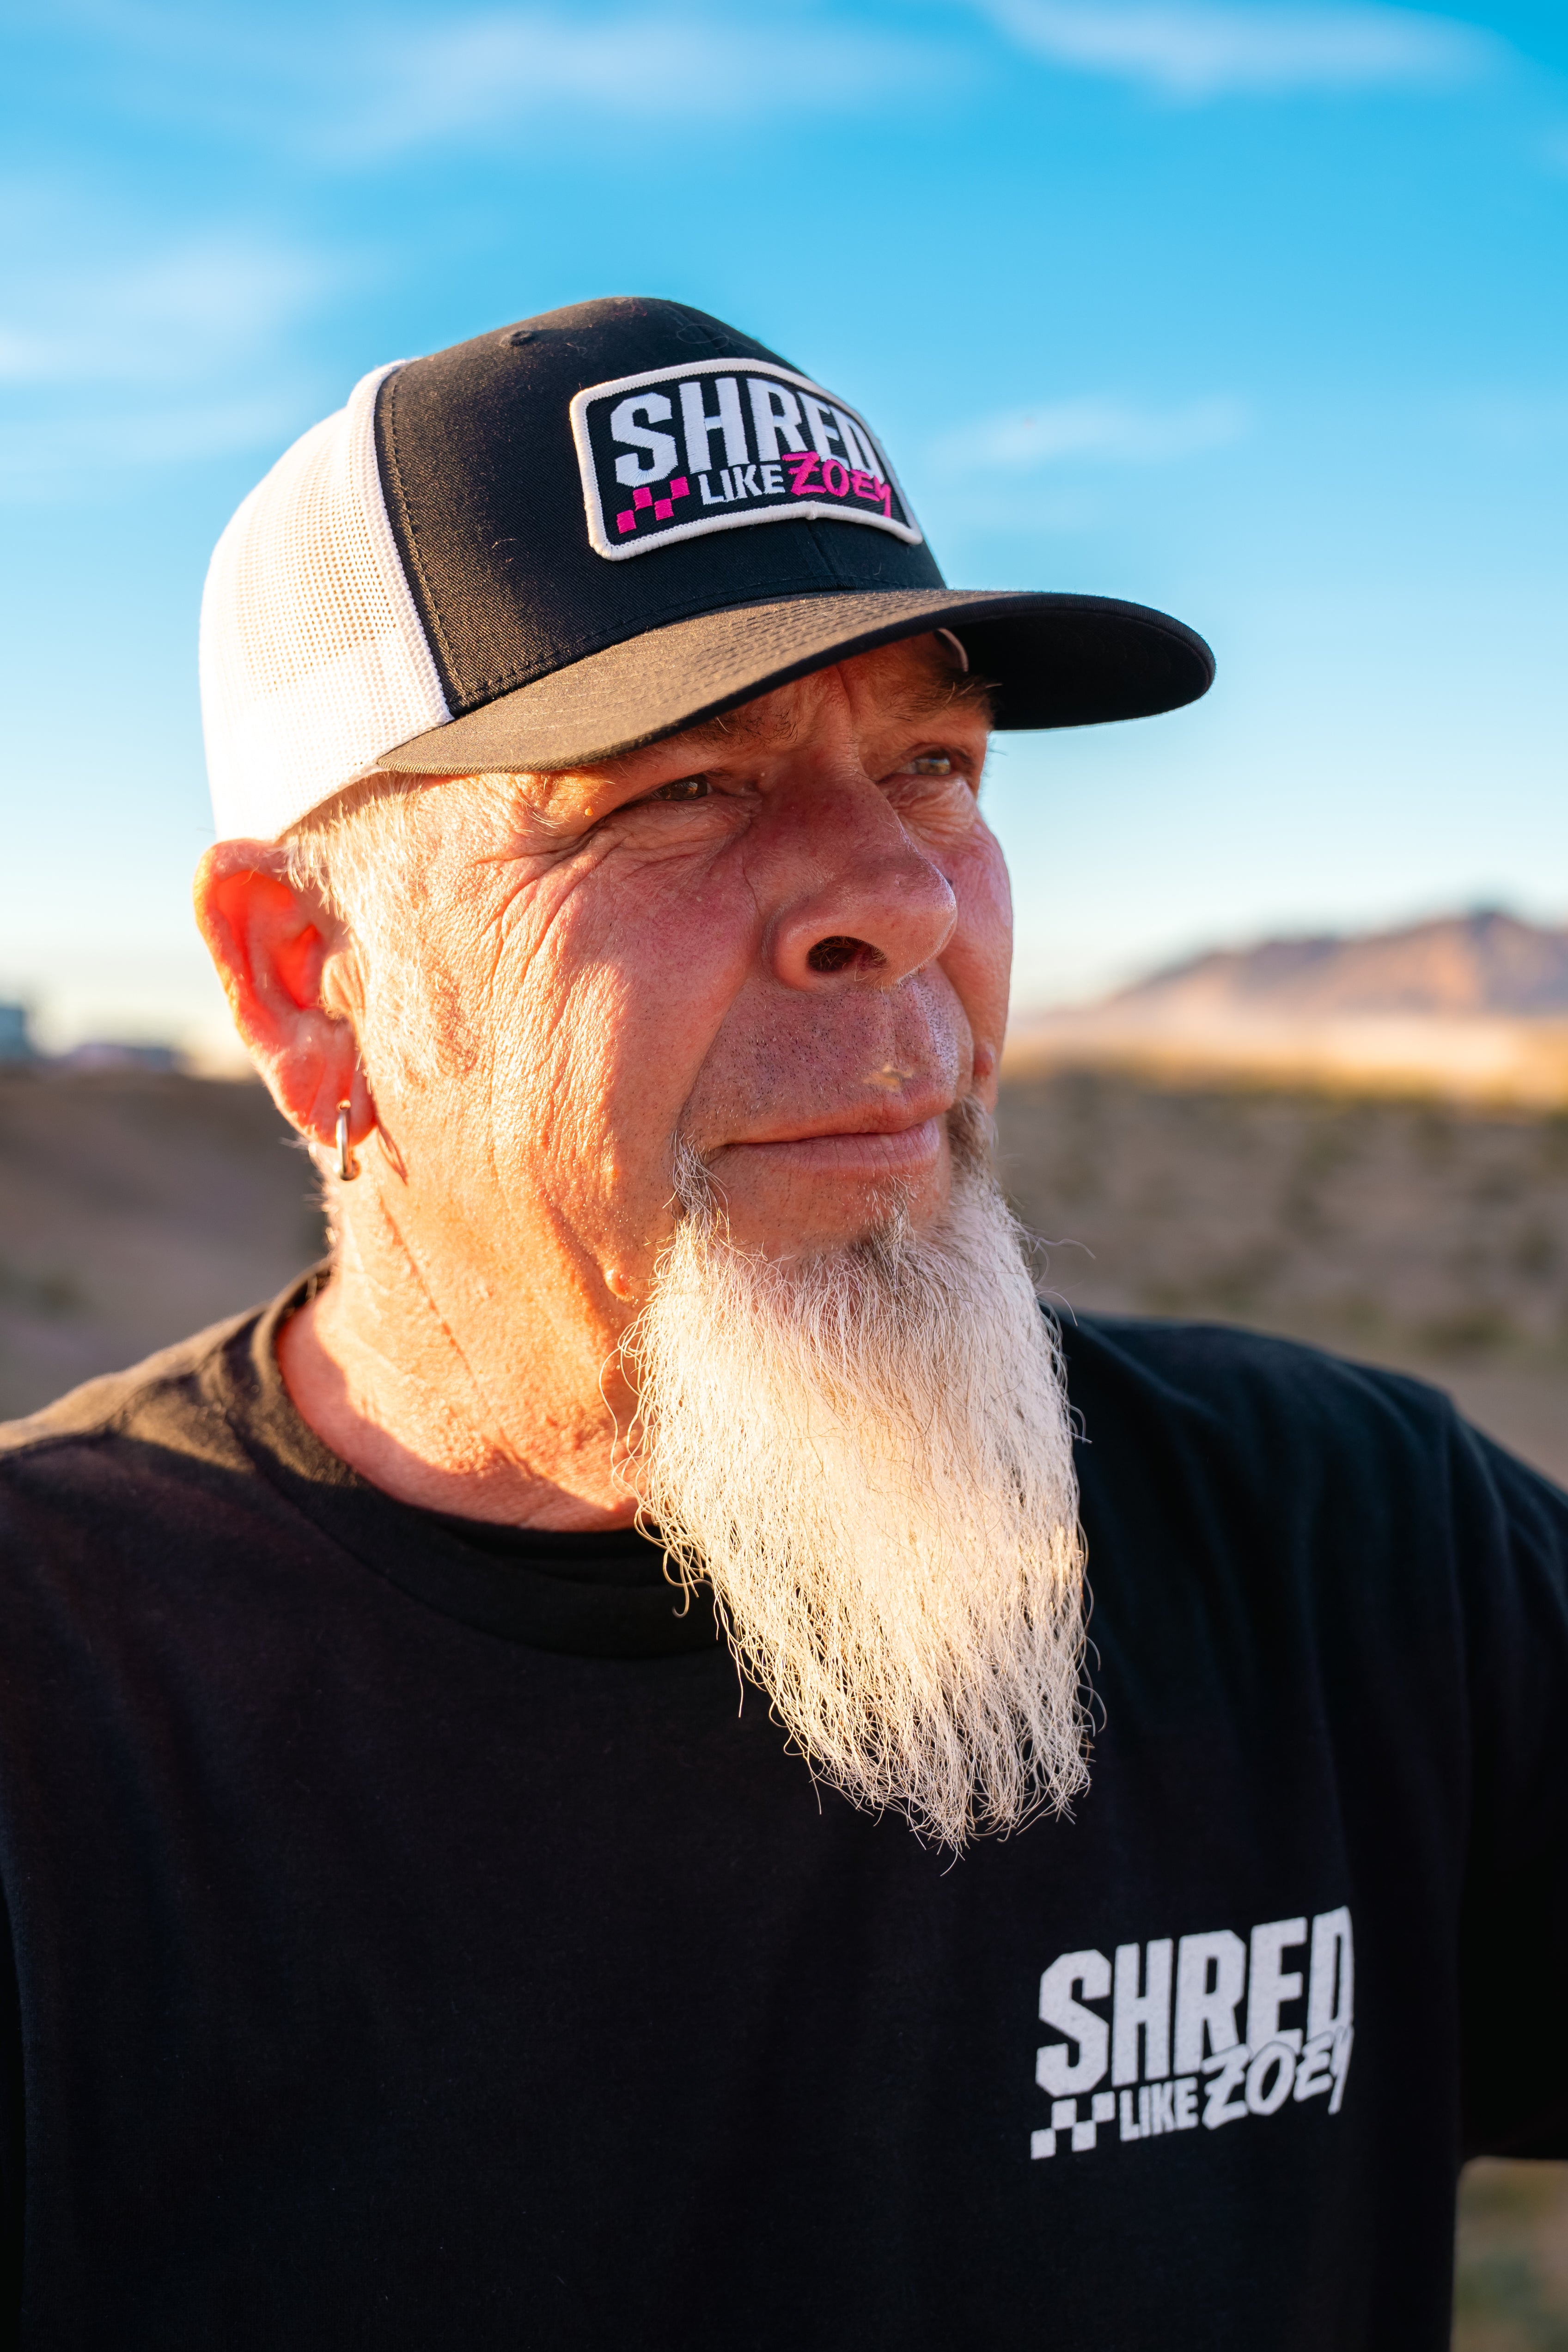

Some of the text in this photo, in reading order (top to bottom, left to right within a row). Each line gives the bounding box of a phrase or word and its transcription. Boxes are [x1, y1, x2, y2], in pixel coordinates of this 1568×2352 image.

[610, 377, 884, 488] SHRED
[699, 451, 892, 518] LIKE ZOEY
[1036, 1905, 1354, 2097] SHRED
[1119, 2025, 1354, 2142] LIKE ZOEY
